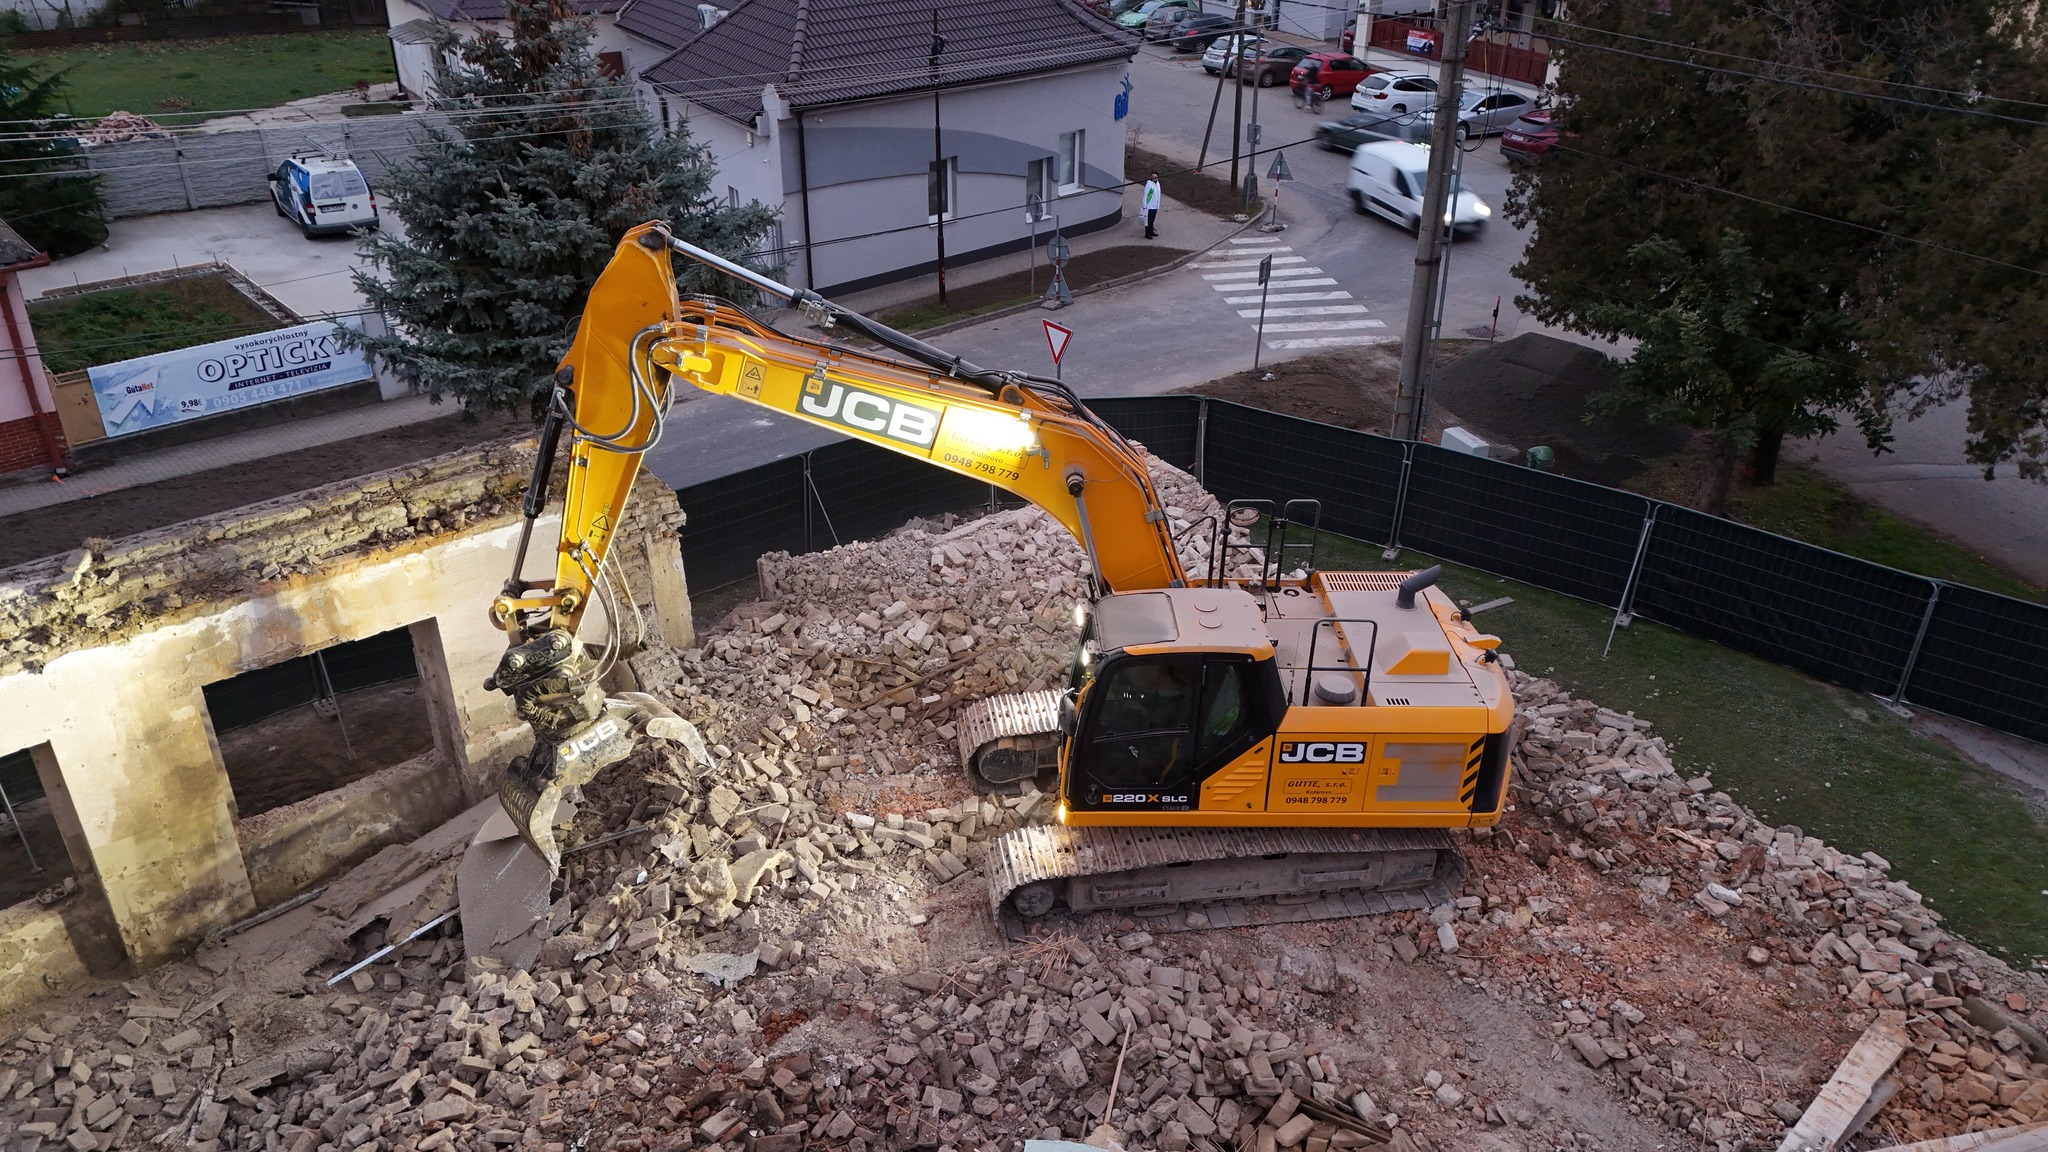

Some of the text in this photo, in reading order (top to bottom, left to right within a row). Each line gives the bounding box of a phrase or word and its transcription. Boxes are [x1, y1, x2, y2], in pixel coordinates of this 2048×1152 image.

[234, 329, 308, 350] vysokorýchlostný
[197, 333, 345, 383] OPTICKY
[126, 382, 154, 394] GútaNet
[234, 375, 277, 389] INTERNET
[286, 363, 328, 378] TELEVÍZIA
[213, 380, 302, 408] 0905 448 471
[802, 384, 937, 446] JCB
[944, 453, 1020, 481] 0948 798 779
[564, 719, 619, 762] JCB
[1281, 743, 1364, 762] JCB
[1161, 795, 1188, 803] SLC
